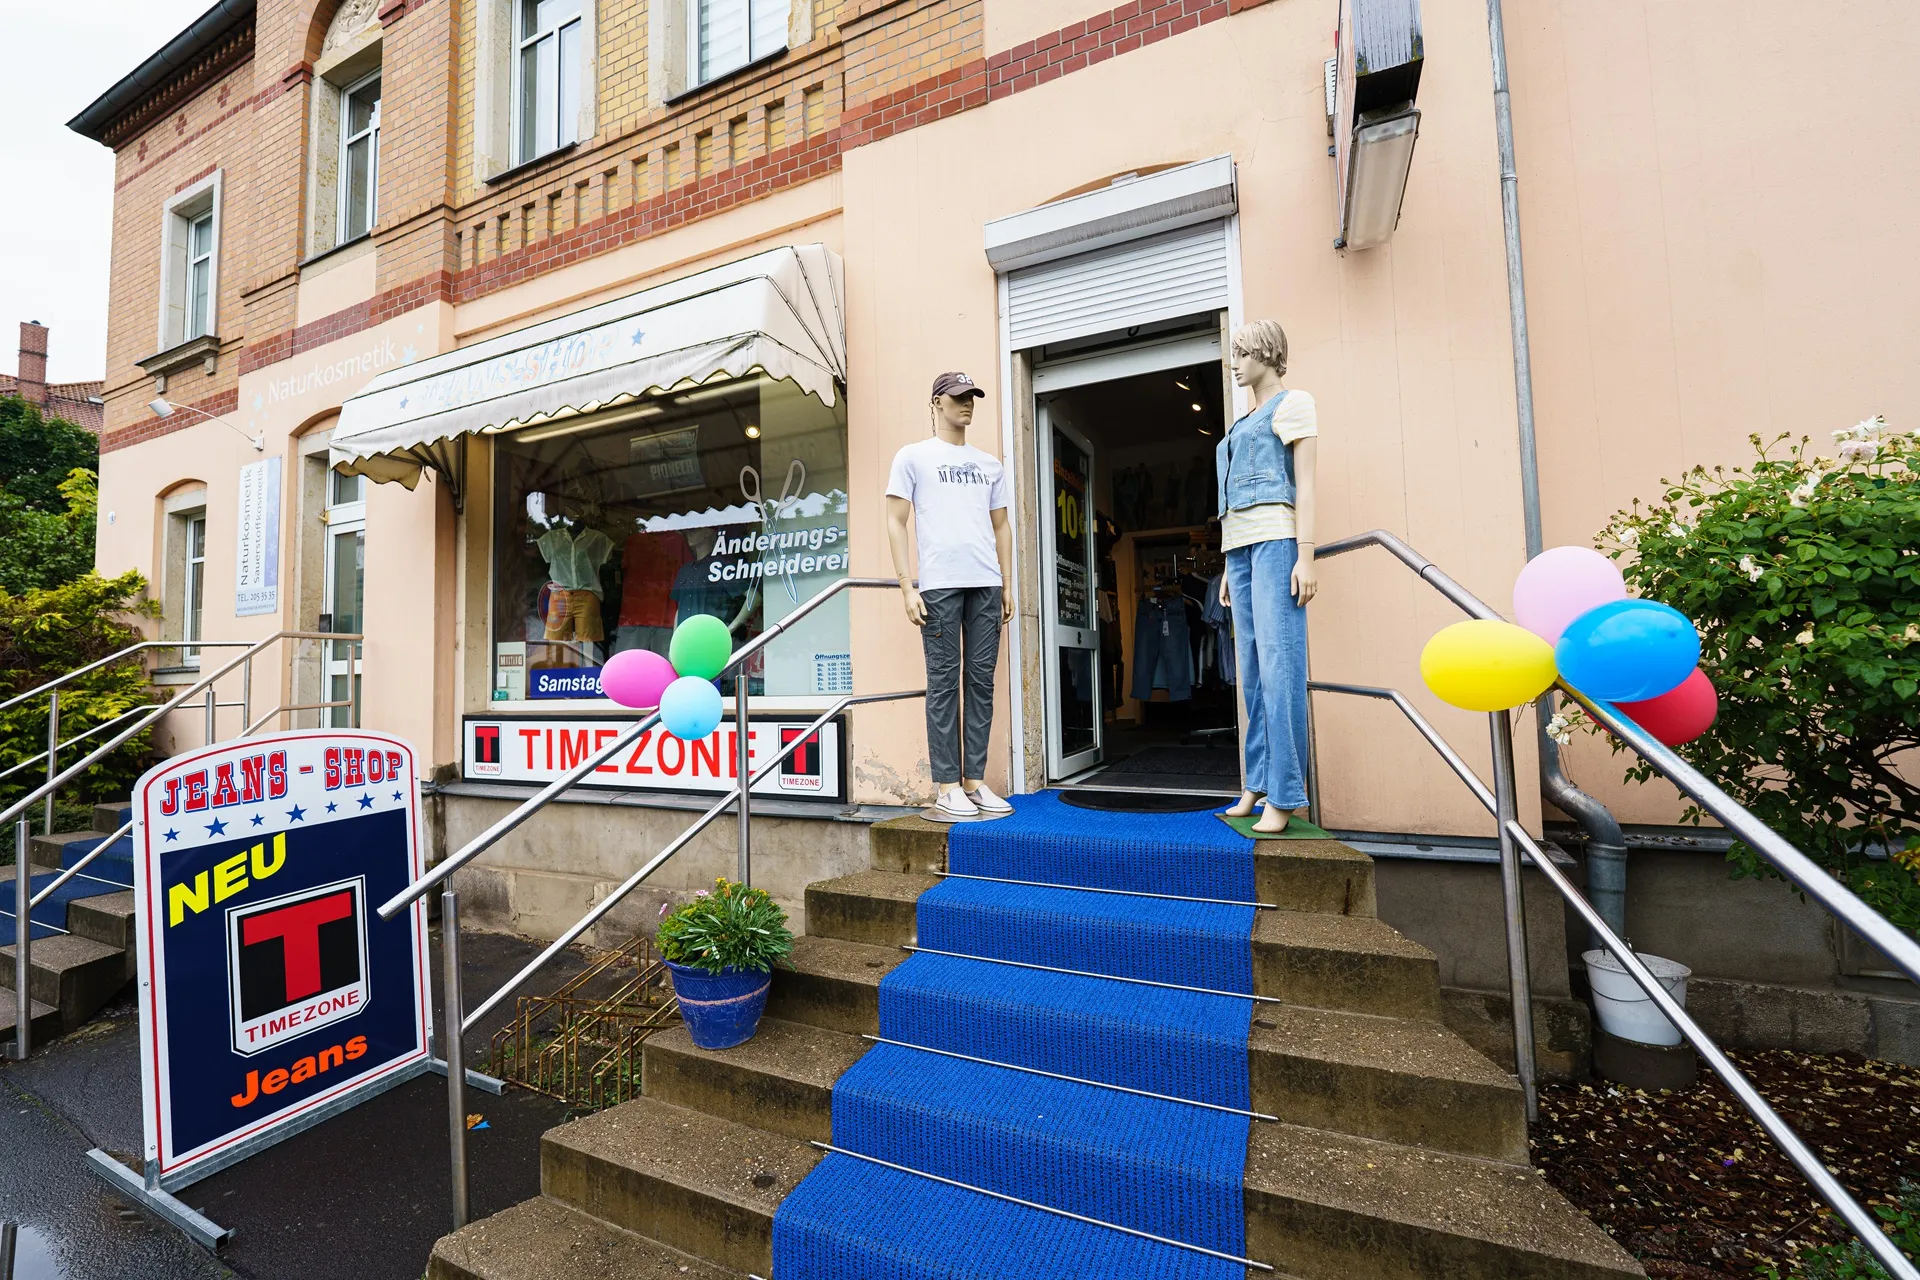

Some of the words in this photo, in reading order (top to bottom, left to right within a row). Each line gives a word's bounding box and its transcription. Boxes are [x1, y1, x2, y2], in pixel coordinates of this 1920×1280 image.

[268, 335, 397, 404] Naturkosmetik
[956, 374, 972, 385] 32
[650, 459, 695, 480] PIONEER
[938, 470, 990, 486] MUSTANG
[241, 469, 252, 586] Naturkosmetik
[253, 465, 264, 584] Sauerstoffkosmetik
[1058, 488, 1078, 539] 10
[708, 547, 849, 582] Schneiderei
[711, 525, 847, 557] Änderungs-
[538, 675, 604, 694] Samstag
[475, 764, 500, 773] TIMEZONE
[518, 729, 757, 779] TIMEZONE
[159, 748, 288, 817] JEANS
[324, 746, 404, 792] SHOP
[782, 777, 821, 787] TIMEZONE
[168, 831, 288, 928] NEU
[244, 989, 361, 1044] TIMEZONE
[231, 1034, 369, 1108] Jeans
